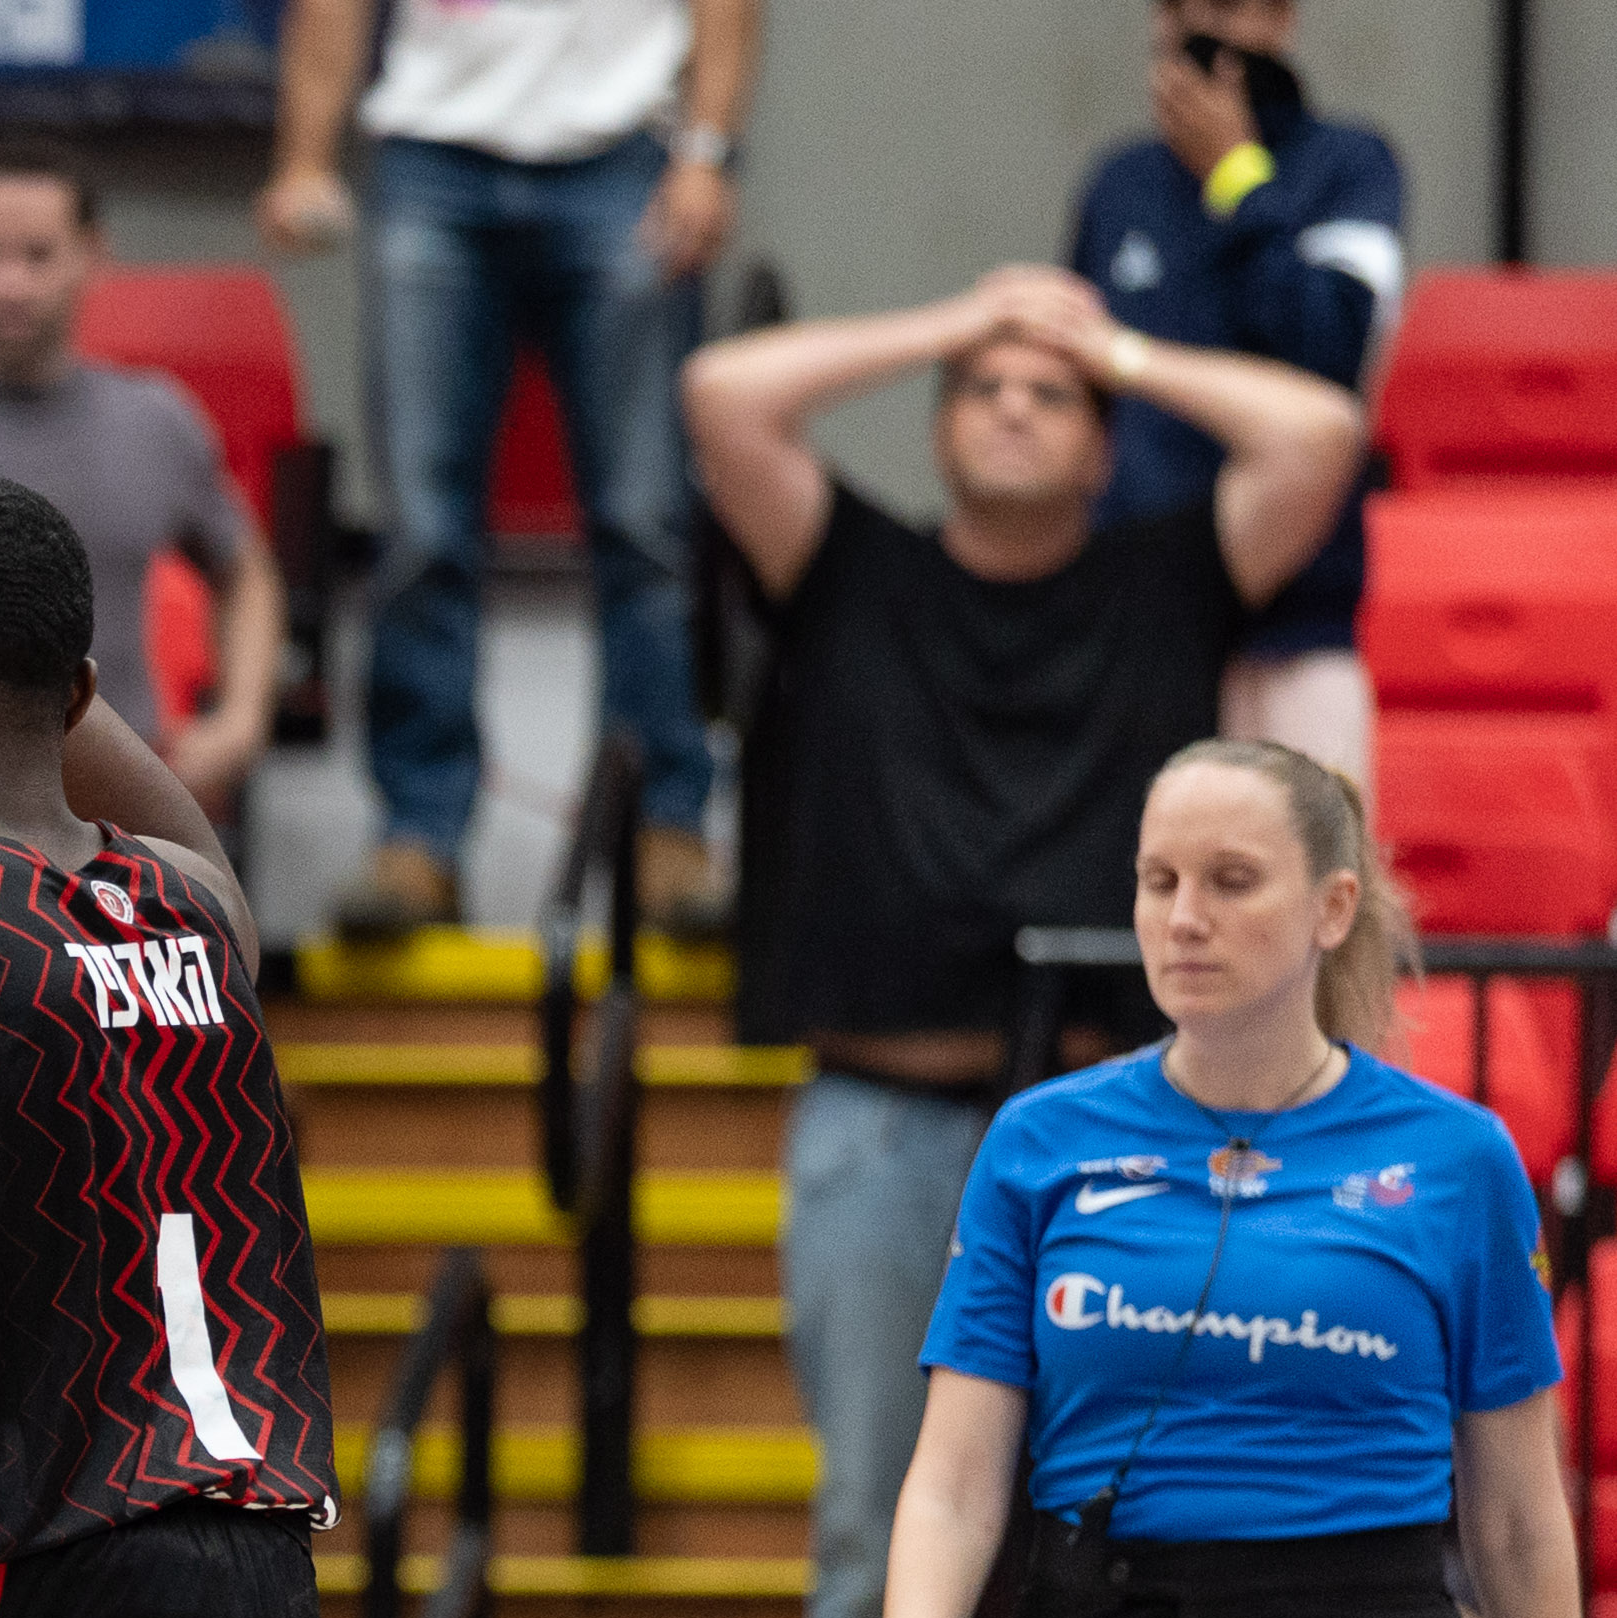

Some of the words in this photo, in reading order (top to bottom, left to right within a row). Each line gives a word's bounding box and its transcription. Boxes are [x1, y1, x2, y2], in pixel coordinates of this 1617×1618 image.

[64, 935, 224, 1028] הארפר
[157, 1213, 264, 1460] 1
[1045, 1272, 1398, 1363] Champion
